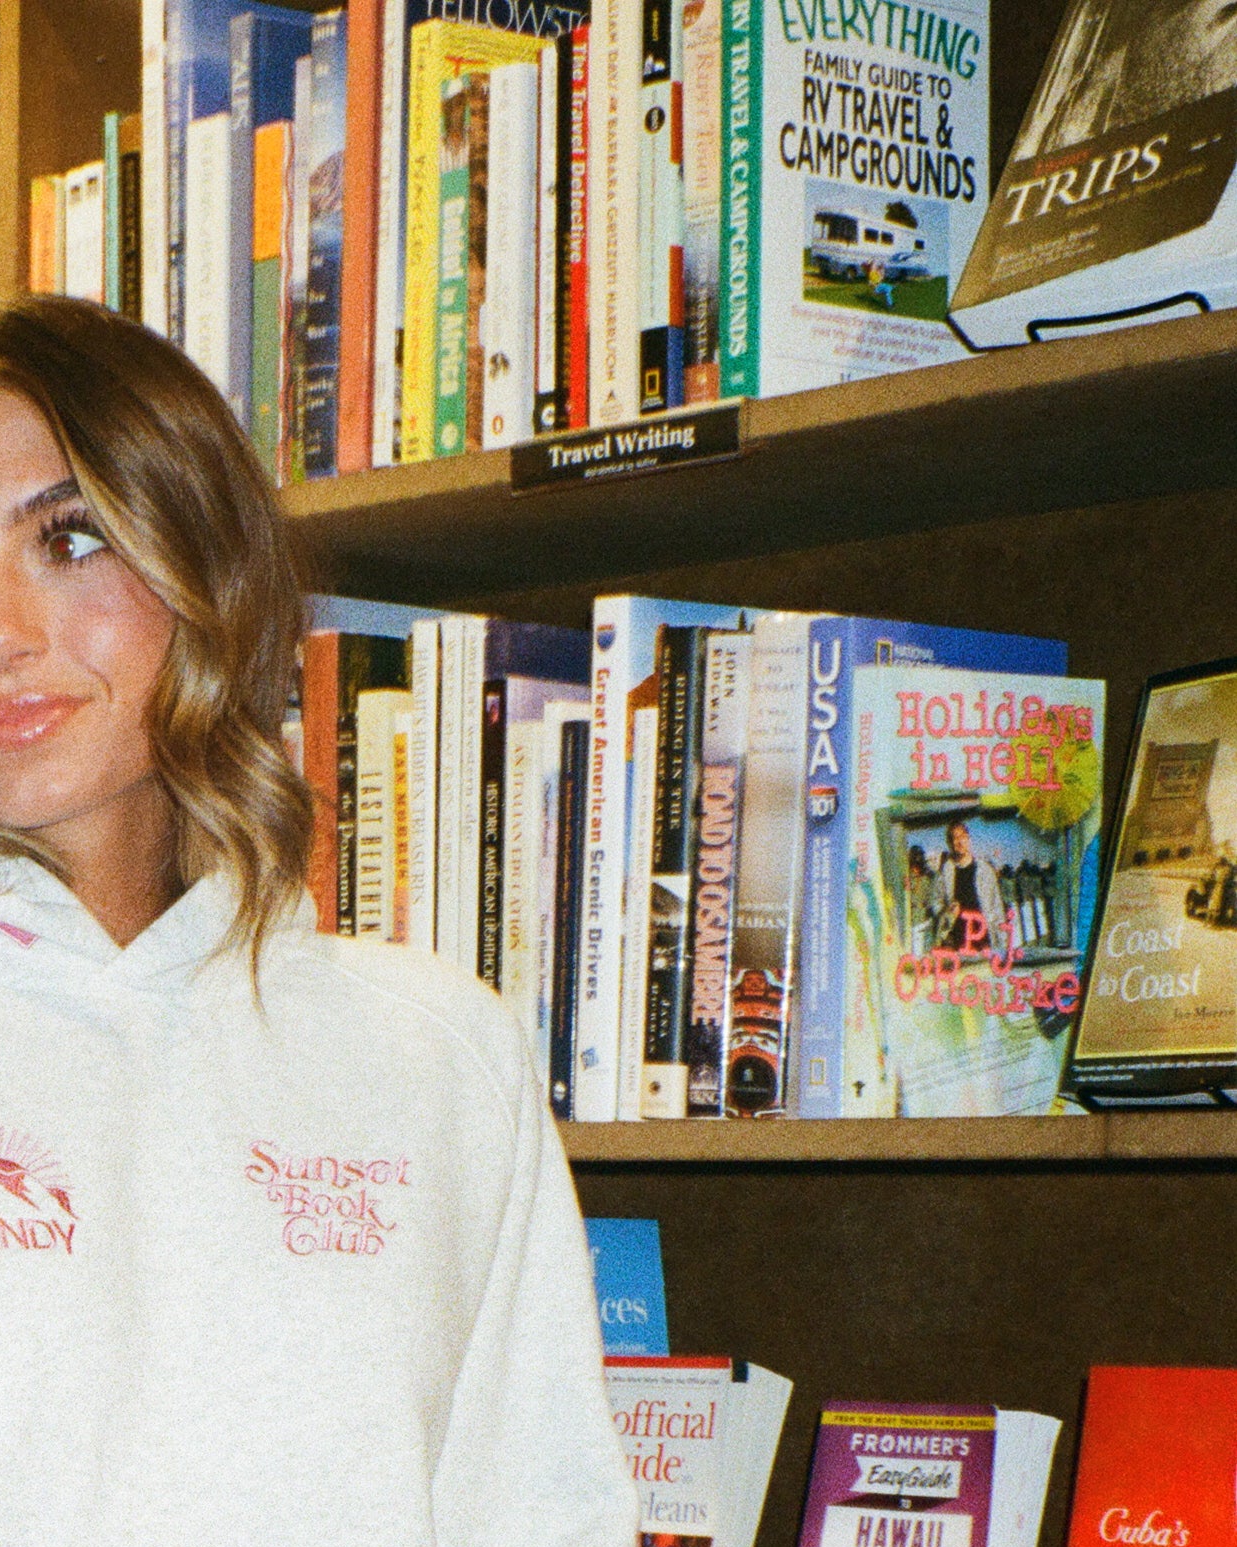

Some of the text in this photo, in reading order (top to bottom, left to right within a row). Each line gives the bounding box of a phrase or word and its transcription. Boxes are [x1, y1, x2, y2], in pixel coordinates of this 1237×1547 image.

[779, 0, 981, 80] EVERYTHING
[728, 38, 750, 132] TRAVEL
[803, 48, 952, 101] FAMILY GUIDE TO
[802, 75, 955, 150] RV TRAVEL &
[568, 43, 586, 266] The Travel Detective
[779, 122, 977, 203] CAMPGROUNDS
[1003, 133, 1170, 228] TRIPS
[728, 161, 750, 359] CAMPGROUNDS
[548, 425, 696, 468] Travel Writing
[706, 646, 723, 737] RIDGWAY
[723, 647, 737, 700] JOHN
[671, 674, 688, 750] RIDING
[808, 638, 841, 778] USA
[895, 689, 1094, 748] Holidays
[909, 740, 1062, 792] in Hell
[668, 787, 684, 831] THE
[698, 766, 738, 846] ROAD
[360, 771, 383, 935] LAST HEATHEN
[584, 666, 612, 1003] Great American Scenic Drives
[483, 782, 500, 983] HISTORIC AMERICAN LIGHTHOU
[689, 884, 732, 1028] OSAMBRE
[1105, 920, 1183, 958] Coast
[1120, 963, 1201, 1003] Coast
[243, 1138, 412, 1190] Sunset
[267, 1184, 397, 1232] Book
[281, 1214, 386, 1256] Club
[600, 1295, 648, 1324] ces
[612, 1399, 716, 1440] official
[850, 1432, 971, 1457] FROMMER'S
[631, 1441, 683, 1484] ide
[866, 1463, 954, 1490] EasyGuide
[645, 1491, 709, 1525] leans
[1099, 1507, 1192, 1547] Cuba's
